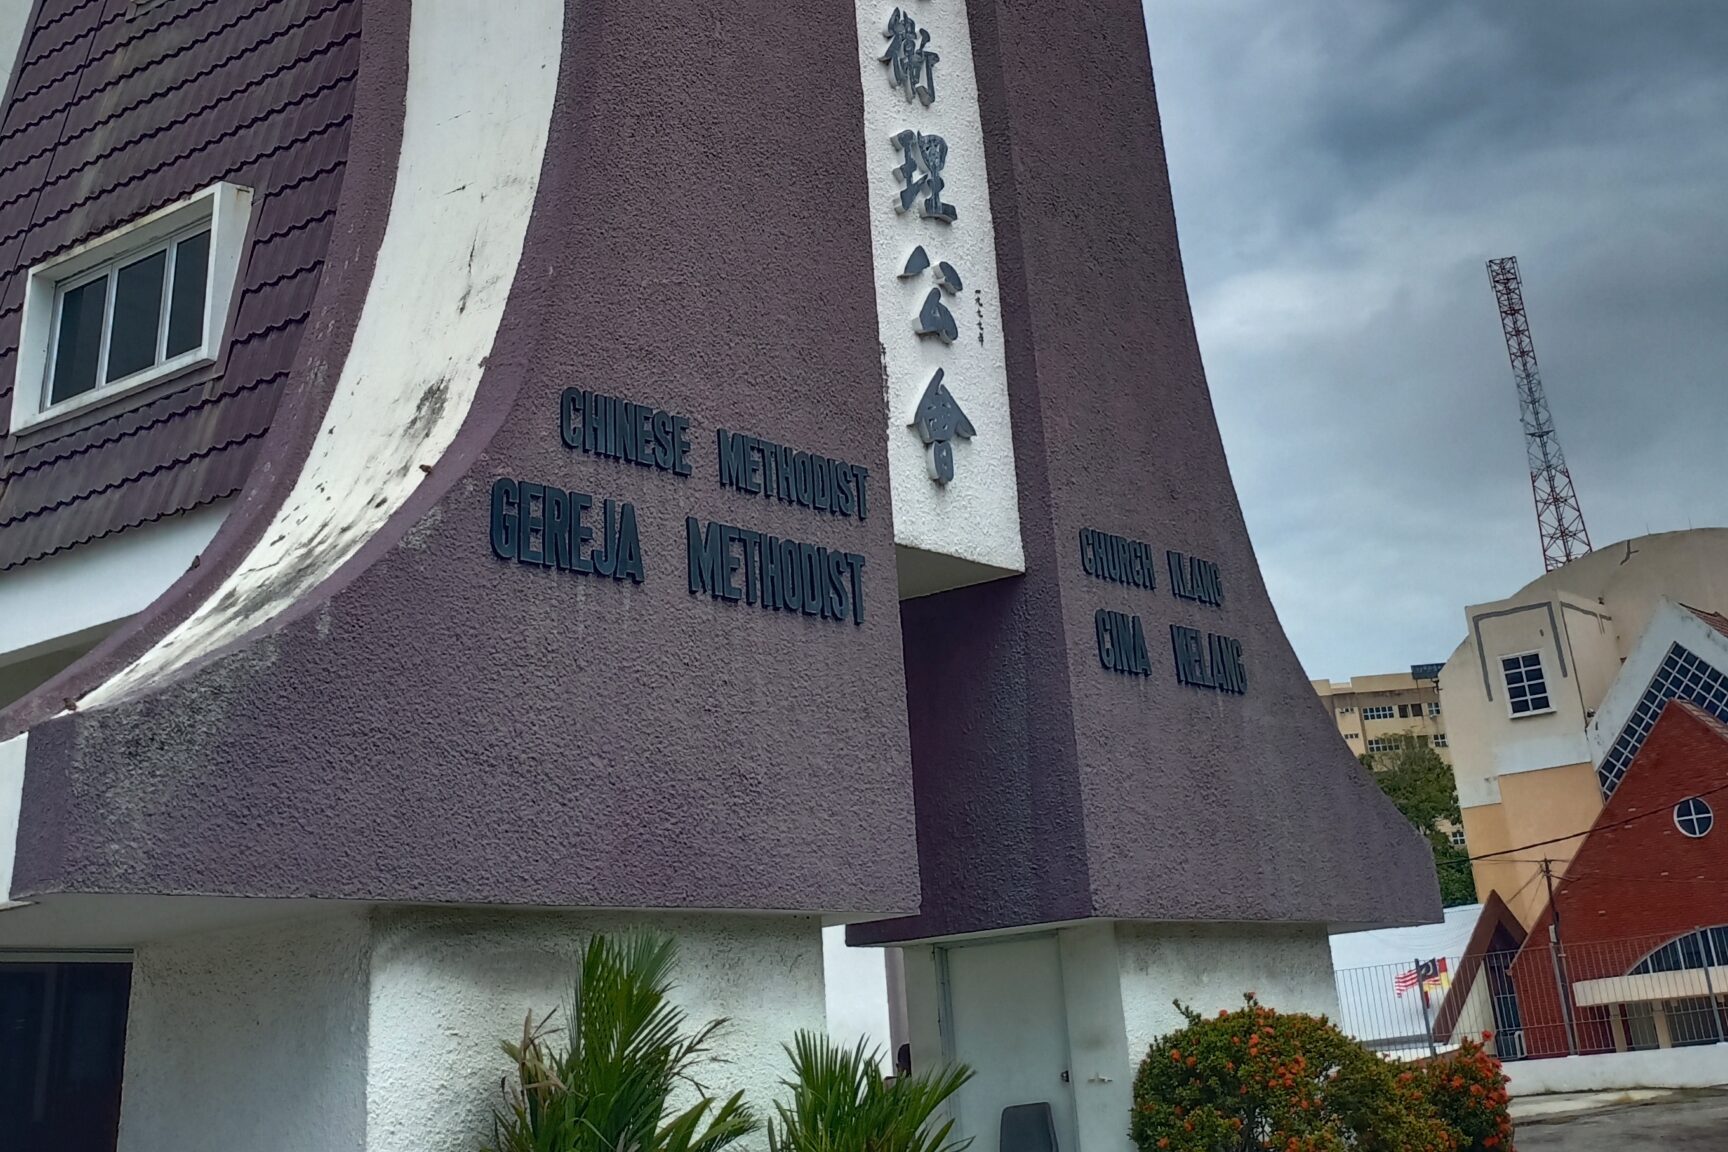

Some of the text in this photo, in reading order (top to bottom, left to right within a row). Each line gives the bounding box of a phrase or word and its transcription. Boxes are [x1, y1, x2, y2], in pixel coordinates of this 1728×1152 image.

[560, 386, 869, 520] CHINESE METHODIST
[490, 478, 866, 625] GEREJA METHODIST
[1079, 527, 1224, 607] CHURCH KLANG
[1095, 608, 1248, 695] CINA KELANG
